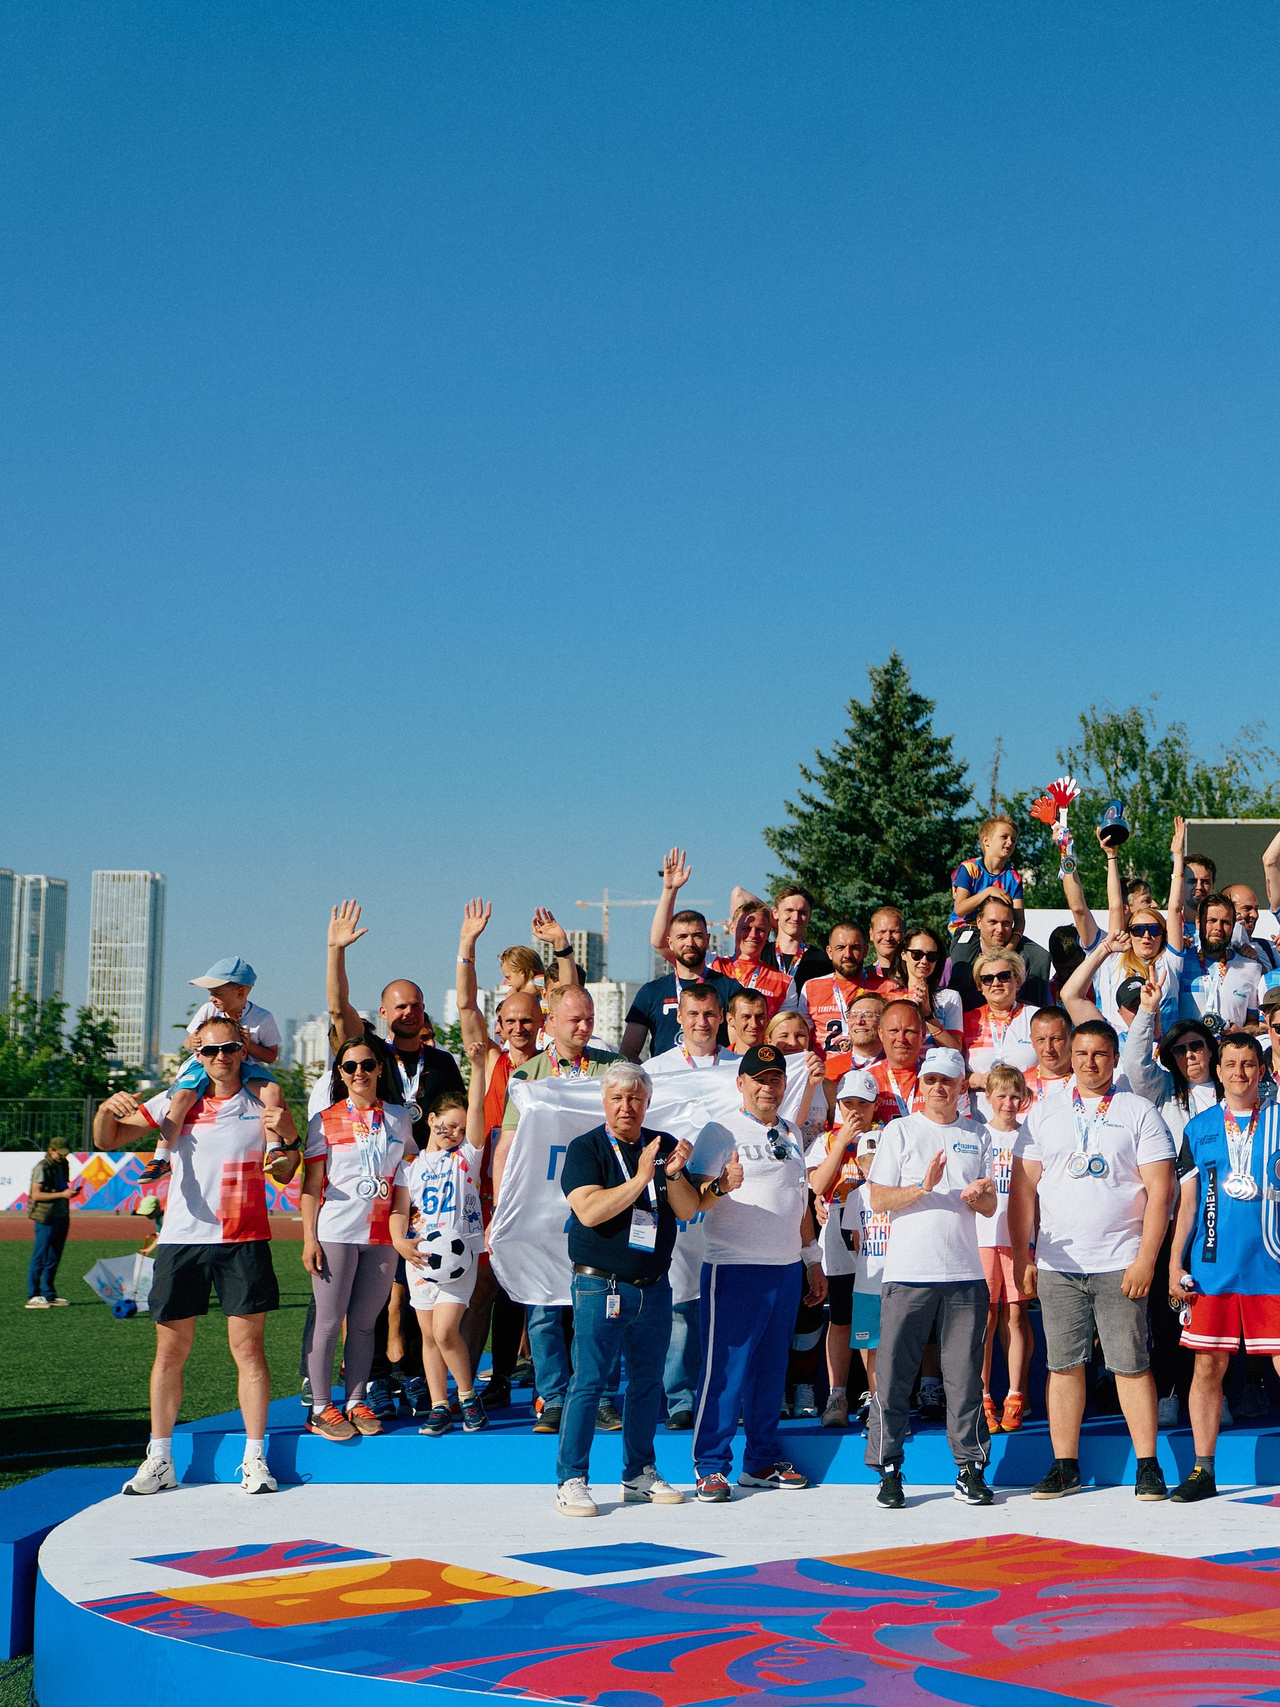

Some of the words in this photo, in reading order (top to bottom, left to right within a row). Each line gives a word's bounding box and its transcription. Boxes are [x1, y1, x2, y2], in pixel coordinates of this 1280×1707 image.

[817, 1005, 841, 1013] ГЕНЕРАЛ
[422, 1180, 456, 1215] 62
[862, 1225, 891, 1241] ЛЕТН
